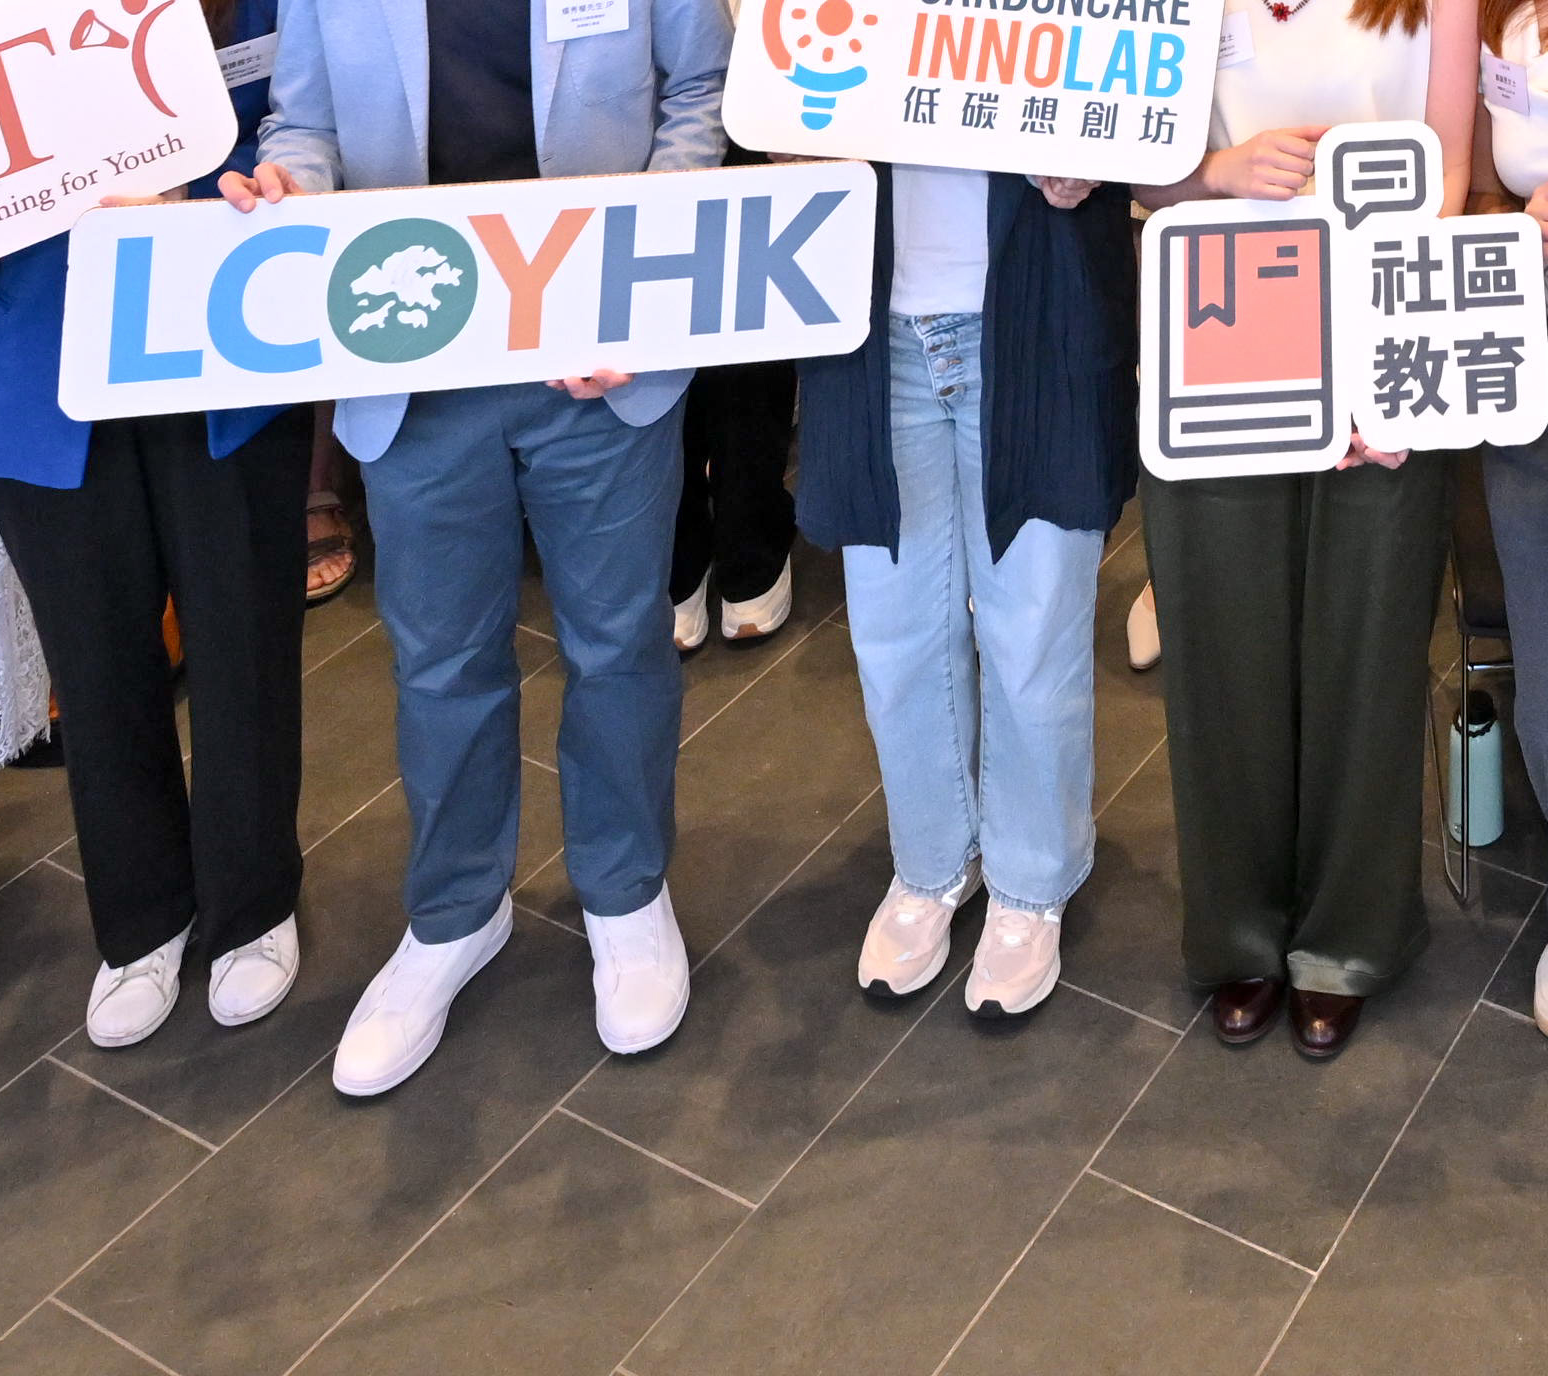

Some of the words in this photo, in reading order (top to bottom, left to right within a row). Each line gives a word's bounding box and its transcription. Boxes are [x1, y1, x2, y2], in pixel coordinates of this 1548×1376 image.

[907, 12, 1186, 99] INNOLAB
[903, 85, 1179, 146] 低碳想創坊
[60, 166, 101, 198] for
[104, 132, 186, 179] Youth
[107, 190, 852, 385] LCOYHK
[1370, 230, 1525, 318] 社區
[1370, 332, 1527, 419] 教育
